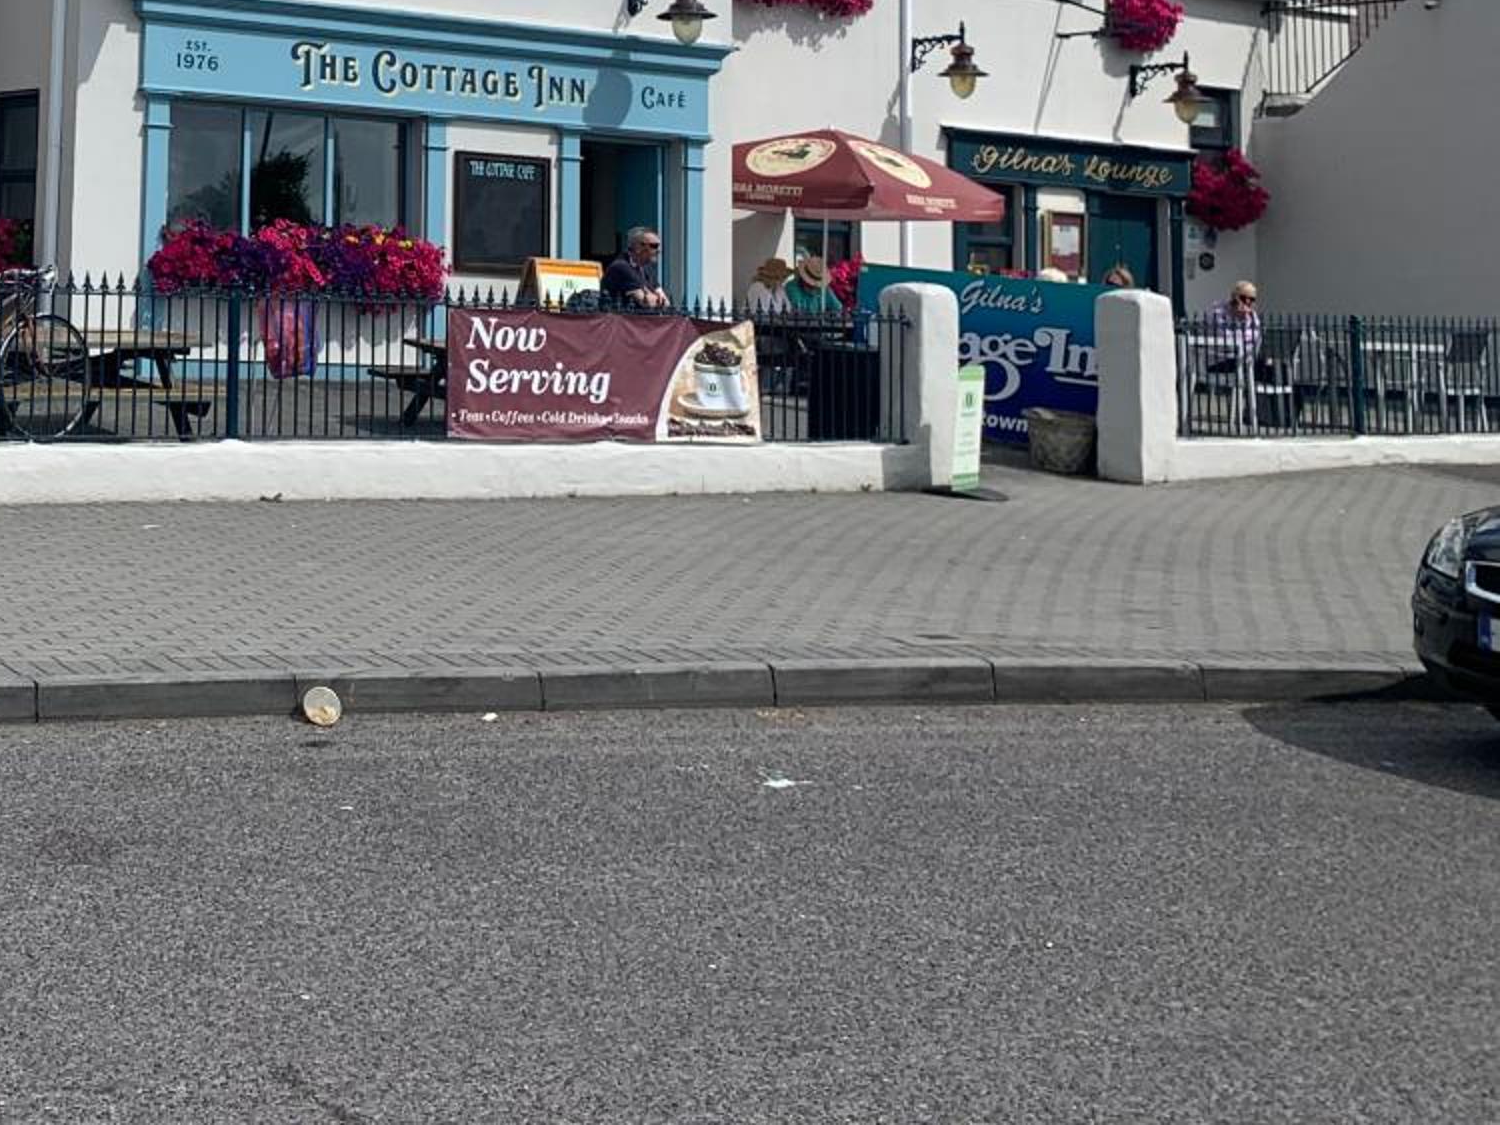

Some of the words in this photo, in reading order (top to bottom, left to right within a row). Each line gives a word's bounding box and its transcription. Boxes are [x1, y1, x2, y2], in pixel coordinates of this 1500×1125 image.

[176, 52, 219, 72] 1976
[291, 41, 361, 90] THE
[371, 50, 521, 100] COTTAGE
[527, 64, 589, 111] INN
[971, 144, 1075, 175] Gilna's
[1084, 154, 1173, 188] Lounge
[961, 279, 1044, 314] Gilna's
[466, 316, 547, 352] Now
[1033, 326, 1099, 377] In
[465, 358, 611, 404] Serving
[459, 409, 484, 422] Teas
[490, 410, 535, 425] Coffees
[541, 410, 566, 424] Cold
